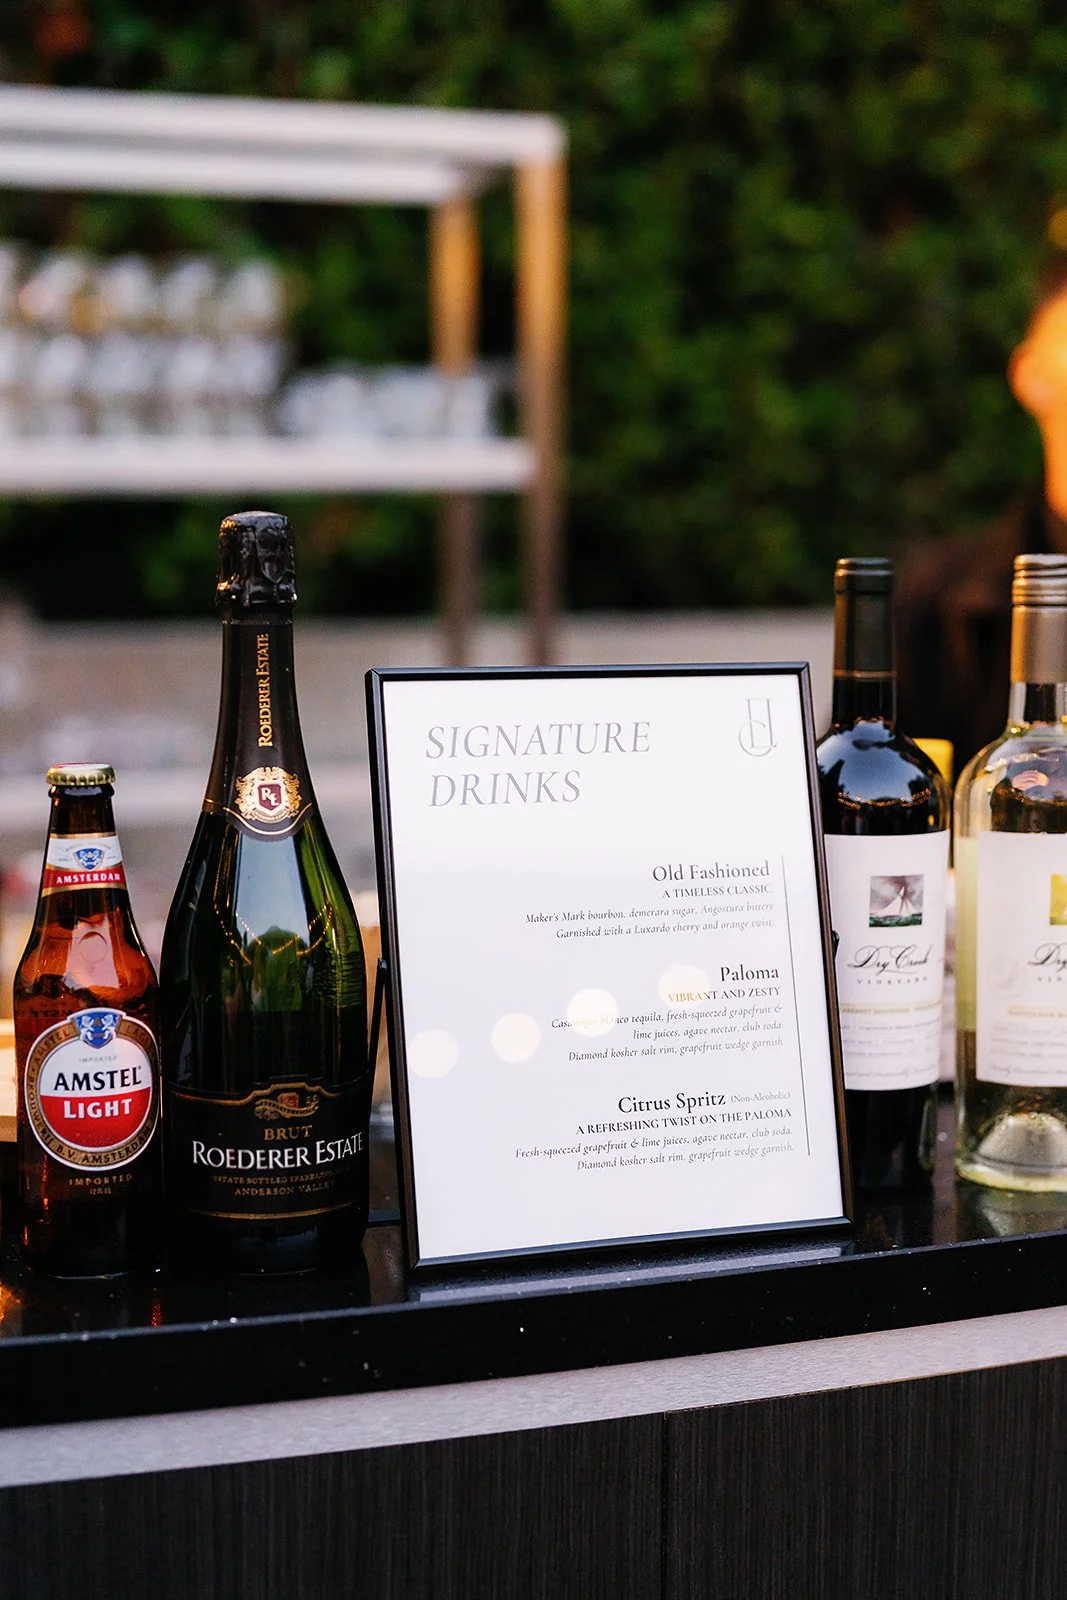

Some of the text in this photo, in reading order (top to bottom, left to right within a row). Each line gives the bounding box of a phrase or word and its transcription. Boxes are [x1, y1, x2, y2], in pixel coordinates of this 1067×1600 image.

[256, 633, 273, 748] ROEDERER ESTATE
[425, 721, 651, 760] SIGNATURE
[428, 769, 582, 807] DRINKS
[652, 859, 770, 881] Old Fashioned
[662, 884, 772, 898] A TIMELESS CLASSIC
[525, 912, 559, 923] Maker's
[562, 910, 585, 921] Mark
[588, 908, 626, 920] bourbon,
[629, 907, 669, 918] demerara
[701, 904, 744, 916] Angostura
[556, 926, 601, 939] Garnished
[604, 925, 623, 936] with
[634, 922, 670, 935] Luxardo
[672, 921, 700, 934] cherry
[702, 920, 719, 931] and
[721, 920, 749, 931] orange
[847, 944, 934, 977] Dry Creek
[720, 963, 779, 982] Paloma
[667, 986, 782, 1002] VIBRANT AND ZESTY
[631, 1011, 664, 1025] tequila,
[666, 1006, 727, 1024] fresh-squeezed
[729, 1003, 771, 1019] grapefruit
[773, 1004, 783, 1013] &
[633, 1029, 652, 1040] lime
[653, 1028, 681, 1041] juices,
[683, 1027, 708, 1038] agave
[742, 1021, 761, 1032] club
[568, 1048, 609, 1061] Diamond
[611, 1046, 638, 1059] kosher
[640, 1045, 657, 1056] salt
[679, 1041, 722, 1056] grapefruit
[724, 1038, 750, 1051] wedge
[54, 1067, 142, 1092] AMSTEL
[63, 1098, 132, 1119] LIGHT
[618, 1091, 791, 1114] Citrus Spritz (Non-Alcoholic)
[264, 1124, 313, 1141] BRUT
[576, 1108, 792, 1135] A REFRESHING TWIST ON THE PALOMA
[82, 1124, 151, 1165] AMSTERDAM
[192, 1131, 364, 1170] ROEDERER ESTATE
[515, 1142, 581, 1158] Fresh-squeezed
[583, 1140, 628, 1155] grapefruit
[630, 1138, 639, 1149] &
[641, 1137, 661, 1148] lime
[662, 1135, 690, 1148] juices,
[692, 1134, 718, 1145] agave
[751, 1127, 770, 1138] club
[772, 1125, 793, 1136] soda.
[577, 1156, 617, 1170] Diamond
[619, 1155, 648, 1167] kosher
[649, 1153, 665, 1164] salt
[688, 1148, 731, 1163] grapefruit
[734, 1145, 759, 1158] wedge
[68, 1173, 133, 1186] IMPORTED
[234, 1186, 295, 1197] ANDERSON
